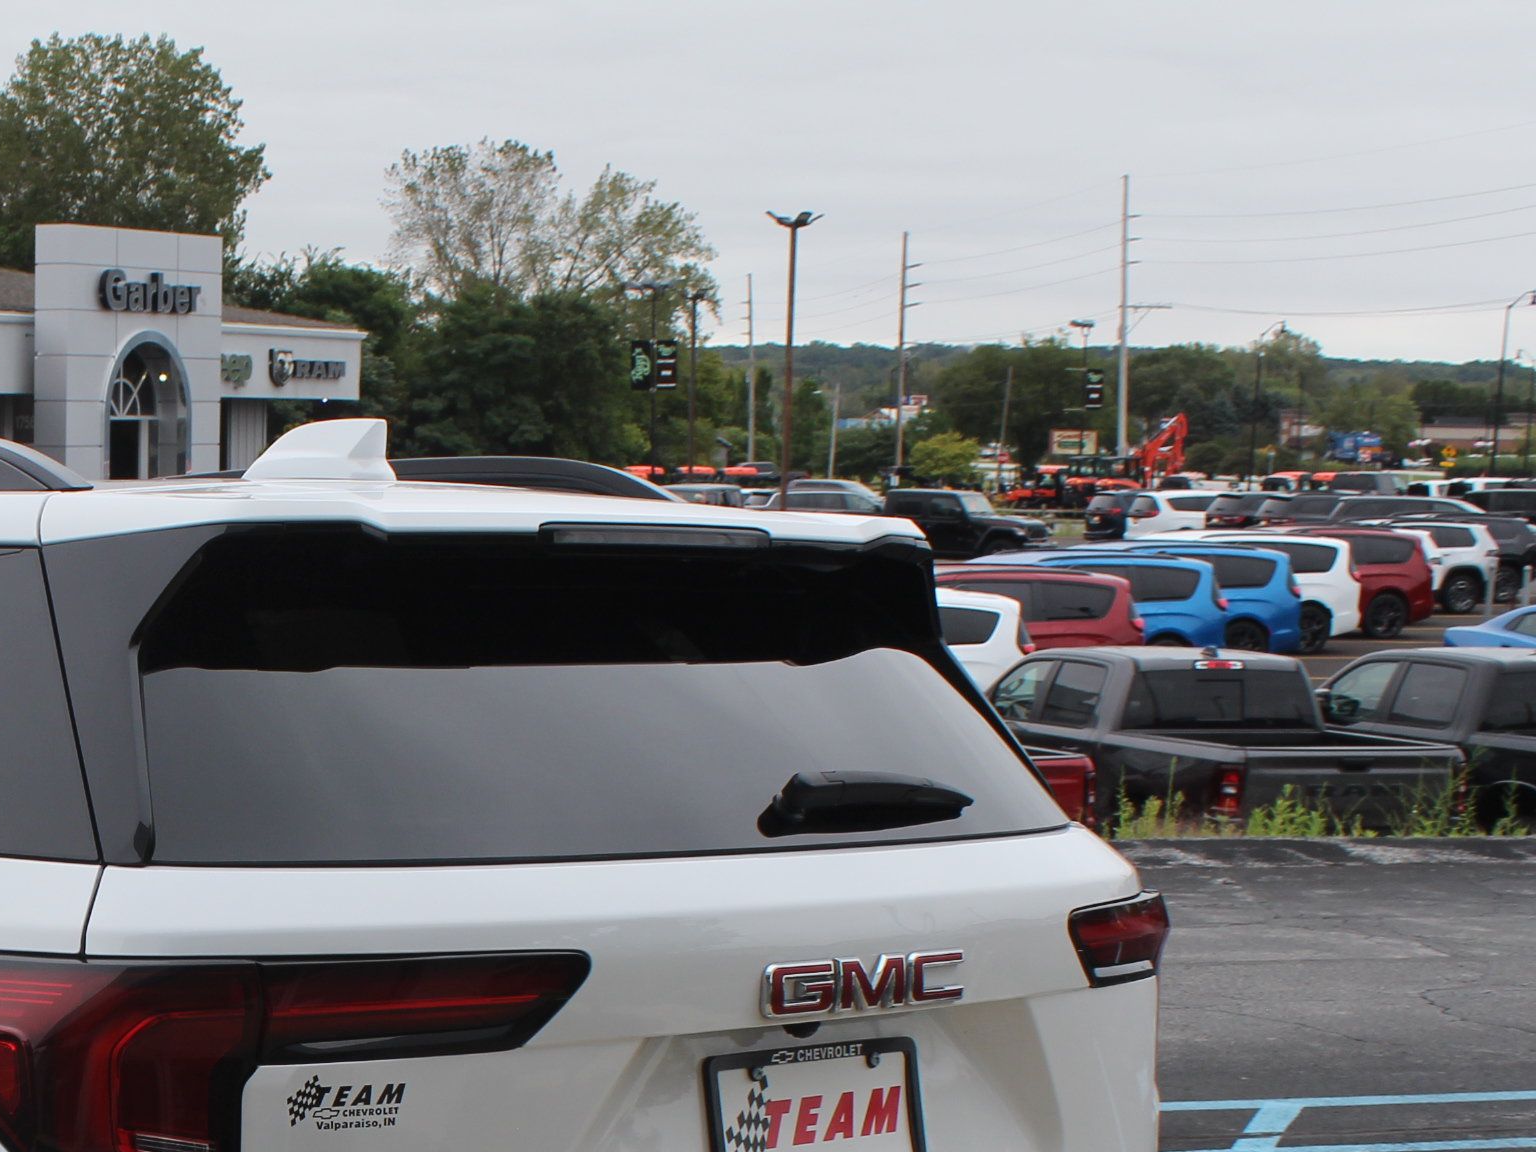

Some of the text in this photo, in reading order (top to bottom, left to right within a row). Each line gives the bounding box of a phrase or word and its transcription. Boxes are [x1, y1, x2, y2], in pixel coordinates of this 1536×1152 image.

[99, 269, 201, 314] Garber
[221, 353, 253, 389] eep
[293, 359, 346, 379] RAM
[760, 949, 965, 1019] GMC
[796, 1043, 863, 1062] CHEVROLET
[313, 1082, 407, 1108] TEAM
[316, 1117, 396, 1131] Valparaiso, IN
[342, 1107, 400, 1117] CHEVROLET
[765, 1085, 902, 1150] TEAM
